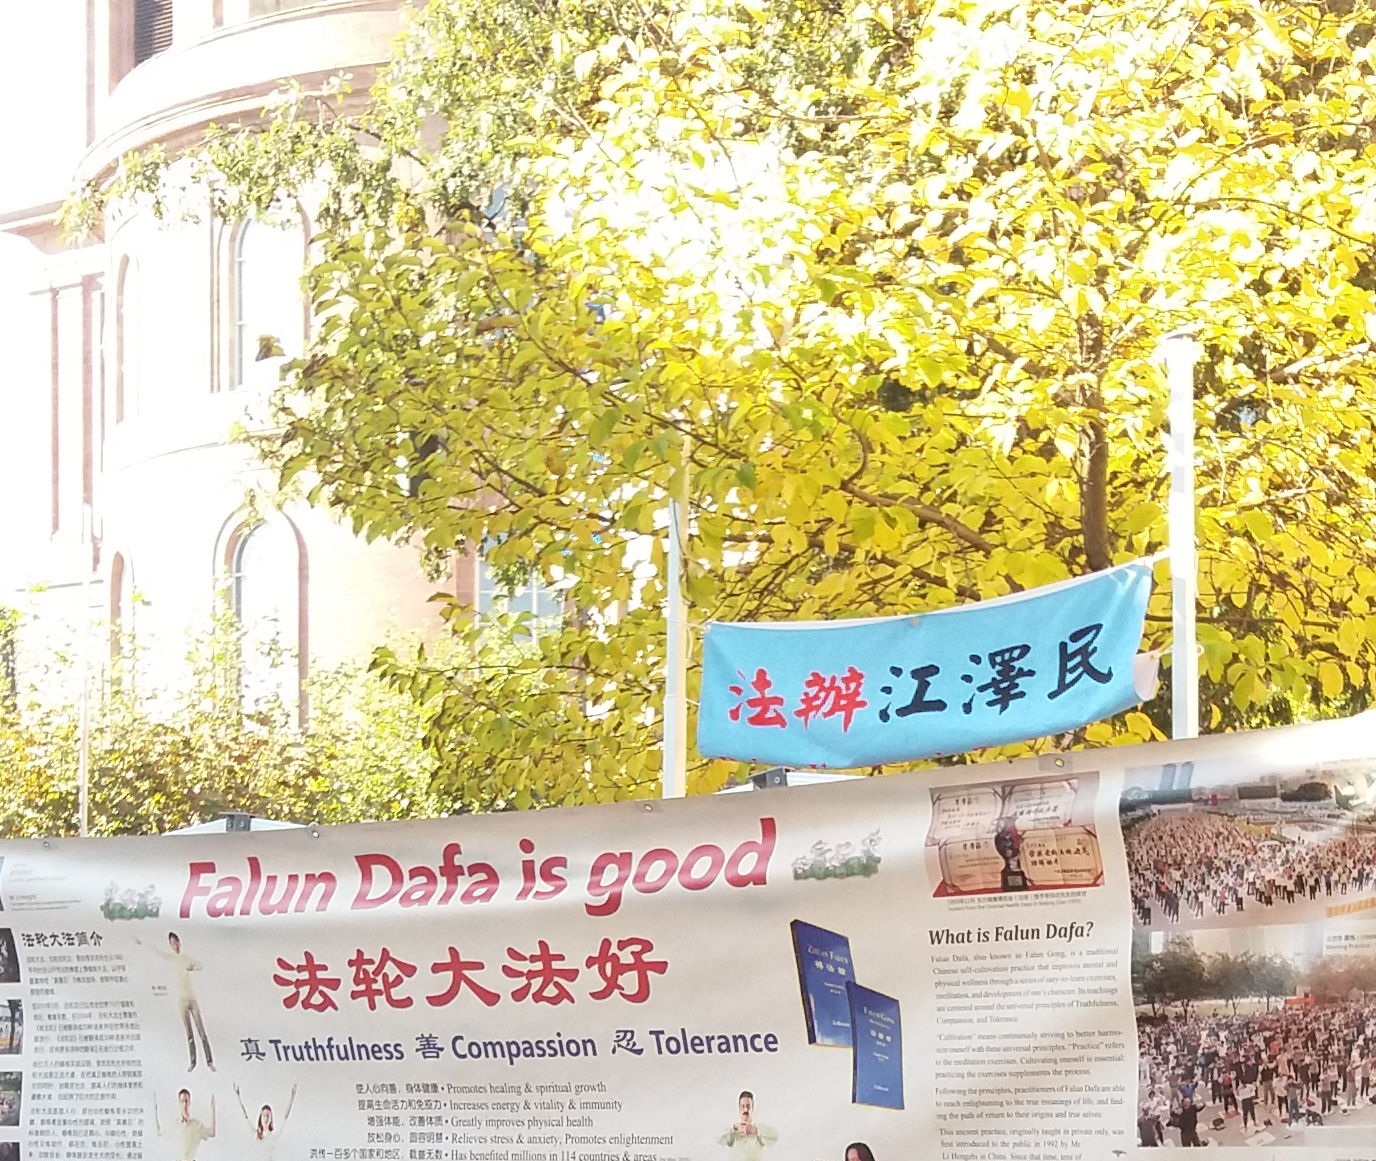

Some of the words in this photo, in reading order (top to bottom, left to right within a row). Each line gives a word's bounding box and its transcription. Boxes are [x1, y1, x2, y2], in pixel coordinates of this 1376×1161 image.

[728, 622, 1114, 732] 法辦江澤民
[178, 855, 337, 919] Falun
[350, 842, 500, 910] Dafa
[516, 837, 568, 900] is
[584, 817, 777, 916] good
[929, 928, 973, 945] What
[977, 928, 990, 943] is
[995, 925, 1040, 942] Falun
[1046, 921, 1094, 942] Dafa?
[272, 936, 668, 1013] 法轮大法好
[239, 1036, 267, 1063] 真
[268, 1036, 405, 1064] Truthfulness
[415, 1032, 444, 1059] 善
[450, 1032, 597, 1065] Compassion
[611, 1028, 645, 1057] 忍
[649, 1026, 779, 1055] Tolerance
[447, 1083, 487, 1094] Promotes
[489, 1083, 522, 1096] healing
[524, 1083, 532, 1093] &
[535, 1082, 572, 1096] spiritual
[574, 1081, 607, 1095] growth
[450, 1101, 489, 1111] Increases
[491, 1102, 521, 1113] energy
[523, 1100, 531, 1110] &
[534, 1100, 565, 1113] vitality
[568, 1100, 576, 1109] &
[579, 1100, 623, 1113] immunity
[451, 1117, 482, 1128] Greatly
[485, 1117, 525, 1128] improves
[527, 1116, 564, 1129] physical
[566, 1116, 593, 1127] health
[451, 1134, 487, 1144] Relieves
[490, 1135, 514, 1144] stress
[516, 1134, 524, 1144] &
[527, 1134, 562, 1146] anxiety,
[565, 1134, 606, 1145] Promotes
[608, 1134, 674, 1147] enlightenment
[451, 1151, 467, 1161] Has
[469, 1150, 509, 1161] benefited
[511, 1151, 547, 1161] millions
[550, 1151, 557, 1161] in
[561, 1151, 576, 1161] 114
[579, 1151, 620, 1161] countries
[622, 1152, 631, 1161] &
